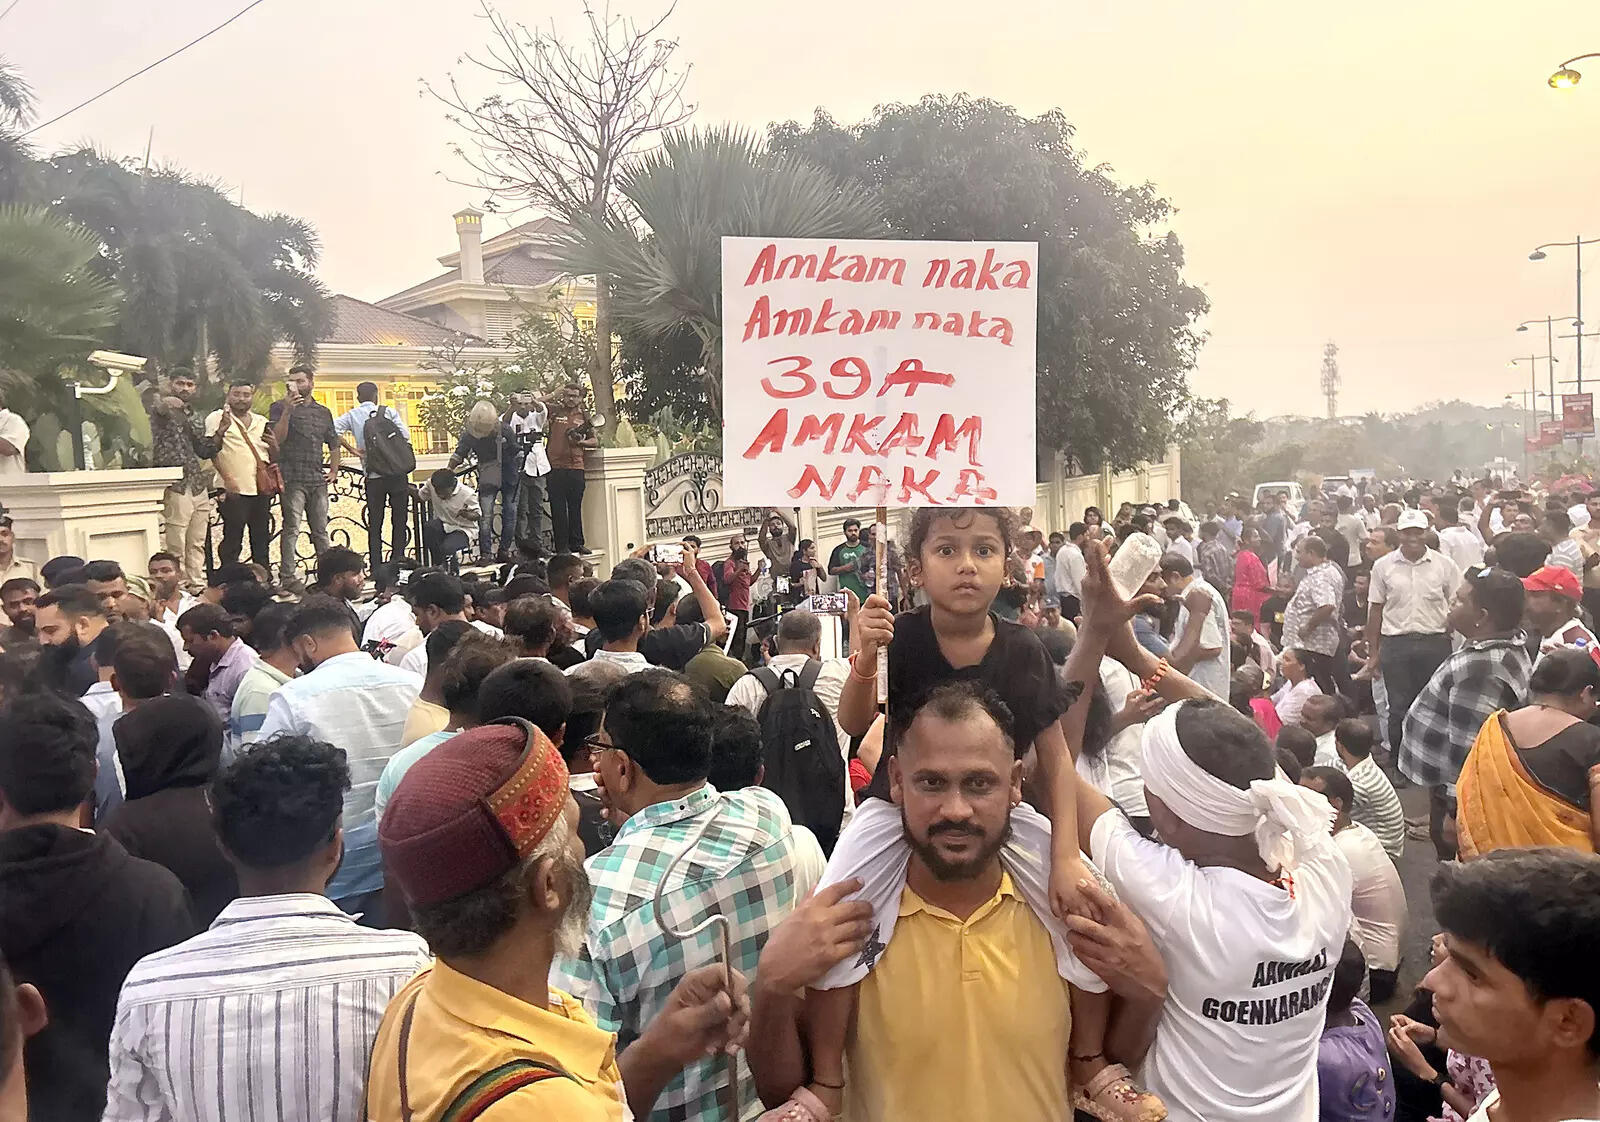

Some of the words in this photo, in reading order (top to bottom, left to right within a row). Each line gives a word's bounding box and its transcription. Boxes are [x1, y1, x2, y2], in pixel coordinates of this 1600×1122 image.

[744, 244, 906, 287] Amkam
[922, 248, 1031, 291] naka
[742, 295, 901, 343] Amkam
[912, 310, 1014, 346] naka
[760, 355, 956, 400] 39A
[742, 408, 983, 466] AMKAM
[786, 464, 998, 505] NAKA
